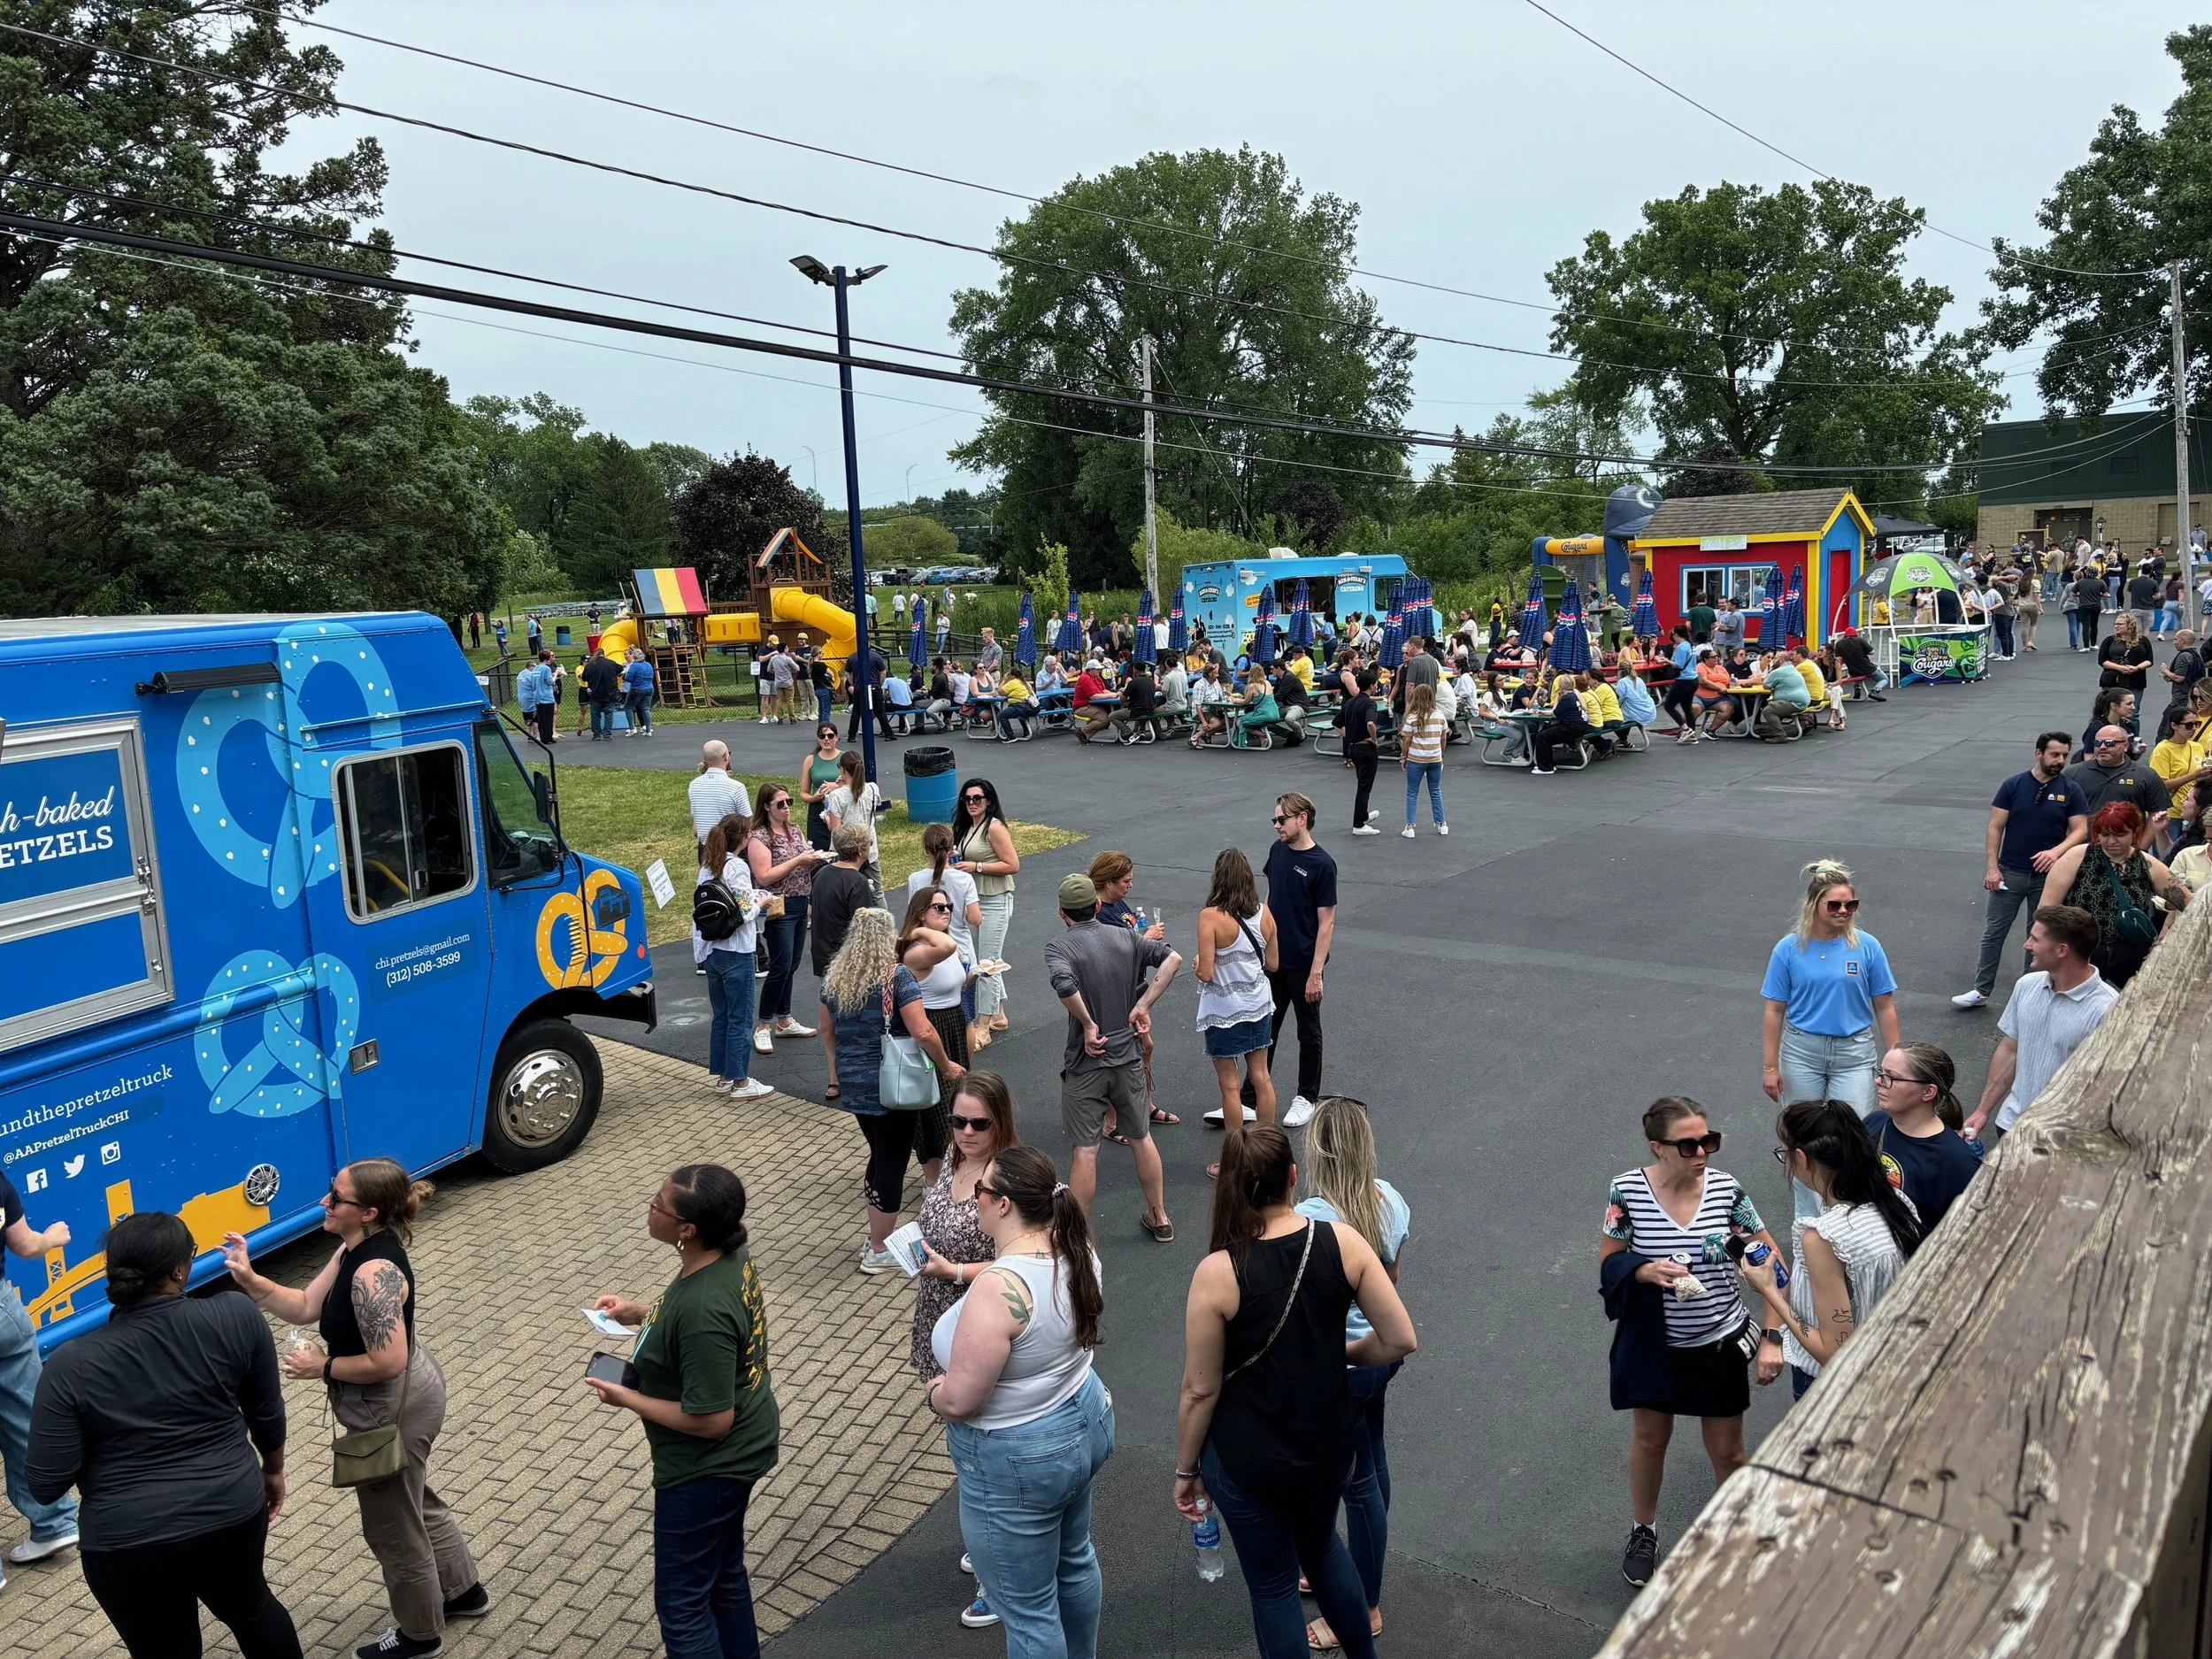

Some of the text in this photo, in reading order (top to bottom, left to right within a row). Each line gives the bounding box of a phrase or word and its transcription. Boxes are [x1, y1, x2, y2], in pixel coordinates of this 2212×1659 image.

[1561, 541, 1587, 555] Cougars
[1912, 657, 1954, 674] Cougars
[0, 826, 114, 869] ETZELS
[375, 933, 471, 970] chi.pretzels@gmail.com
[387, 951, 460, 987] (312) 508-3599
[4, 1110, 130, 1164] @AAPretzelTruckCHI
